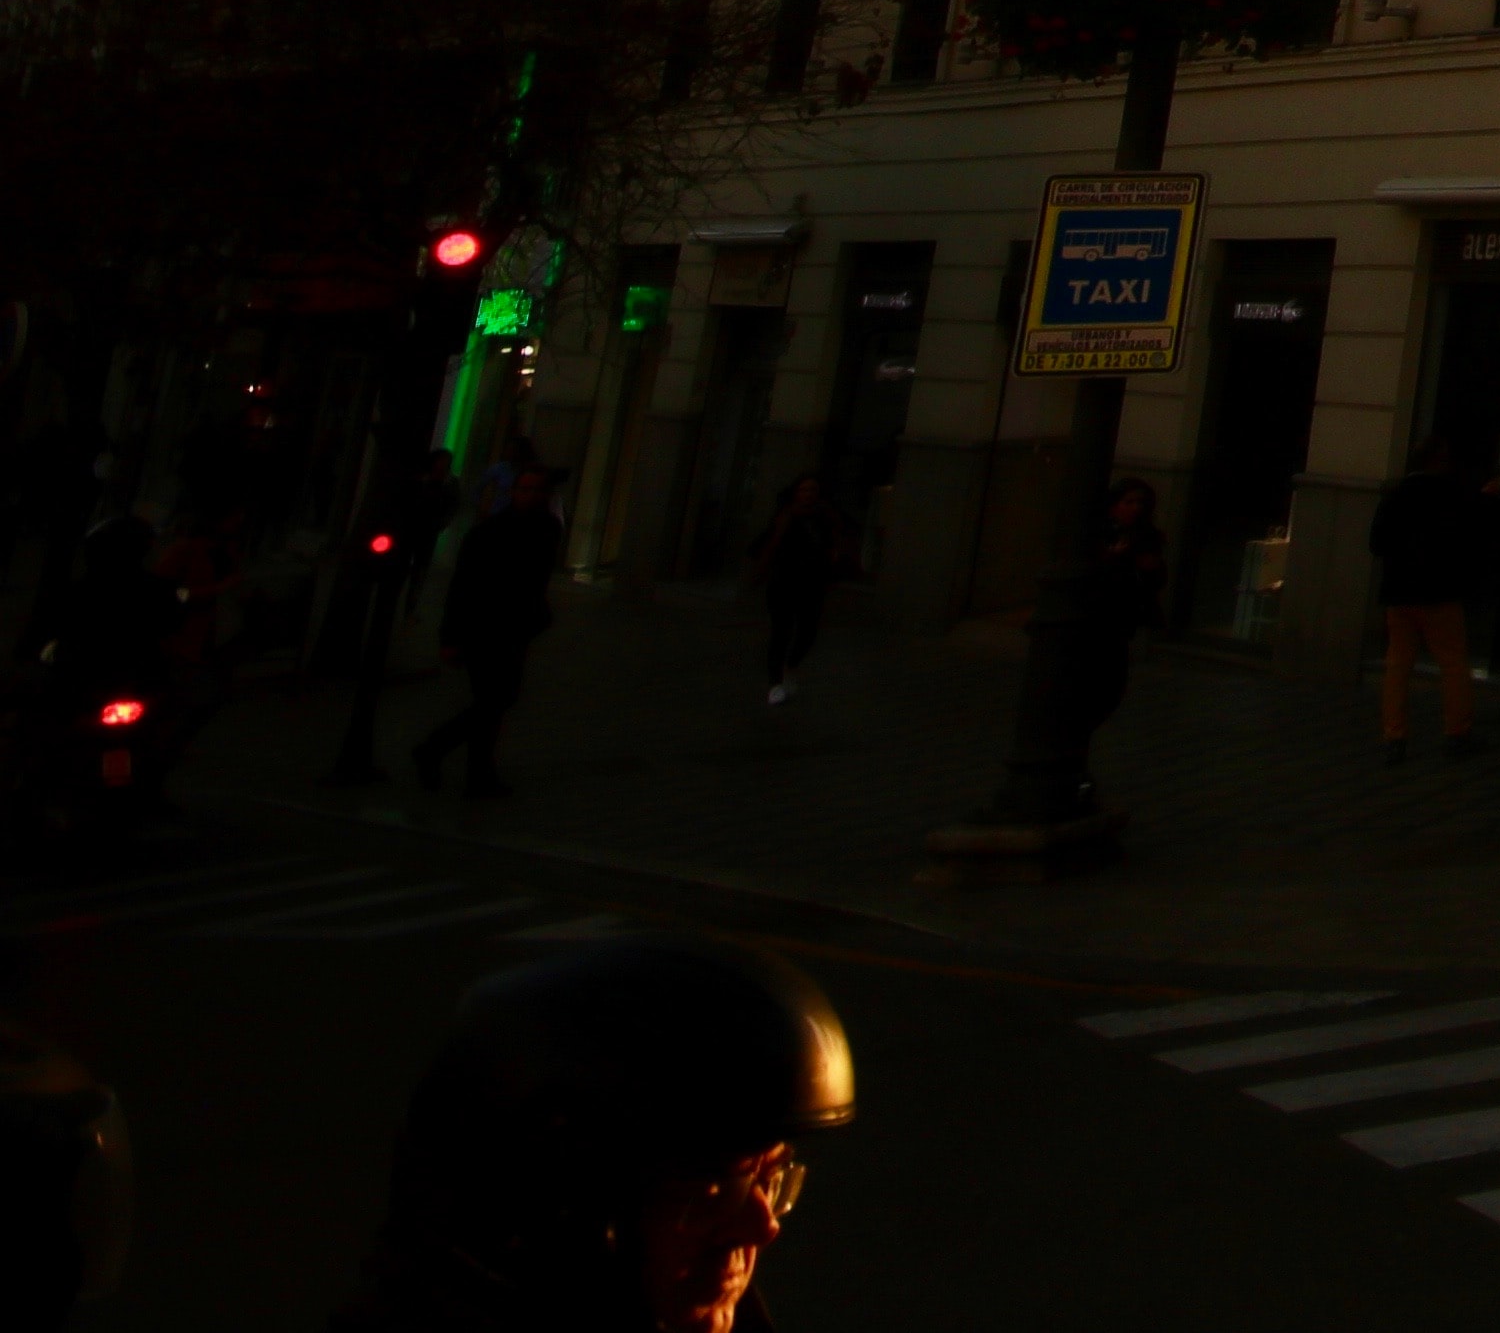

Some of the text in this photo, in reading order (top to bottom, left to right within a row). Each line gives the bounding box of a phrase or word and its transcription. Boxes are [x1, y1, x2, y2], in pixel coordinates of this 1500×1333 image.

[1067, 279, 1152, 306] TAXI
[1025, 355, 1045, 369] DE
[1089, 354, 1099, 367] A
